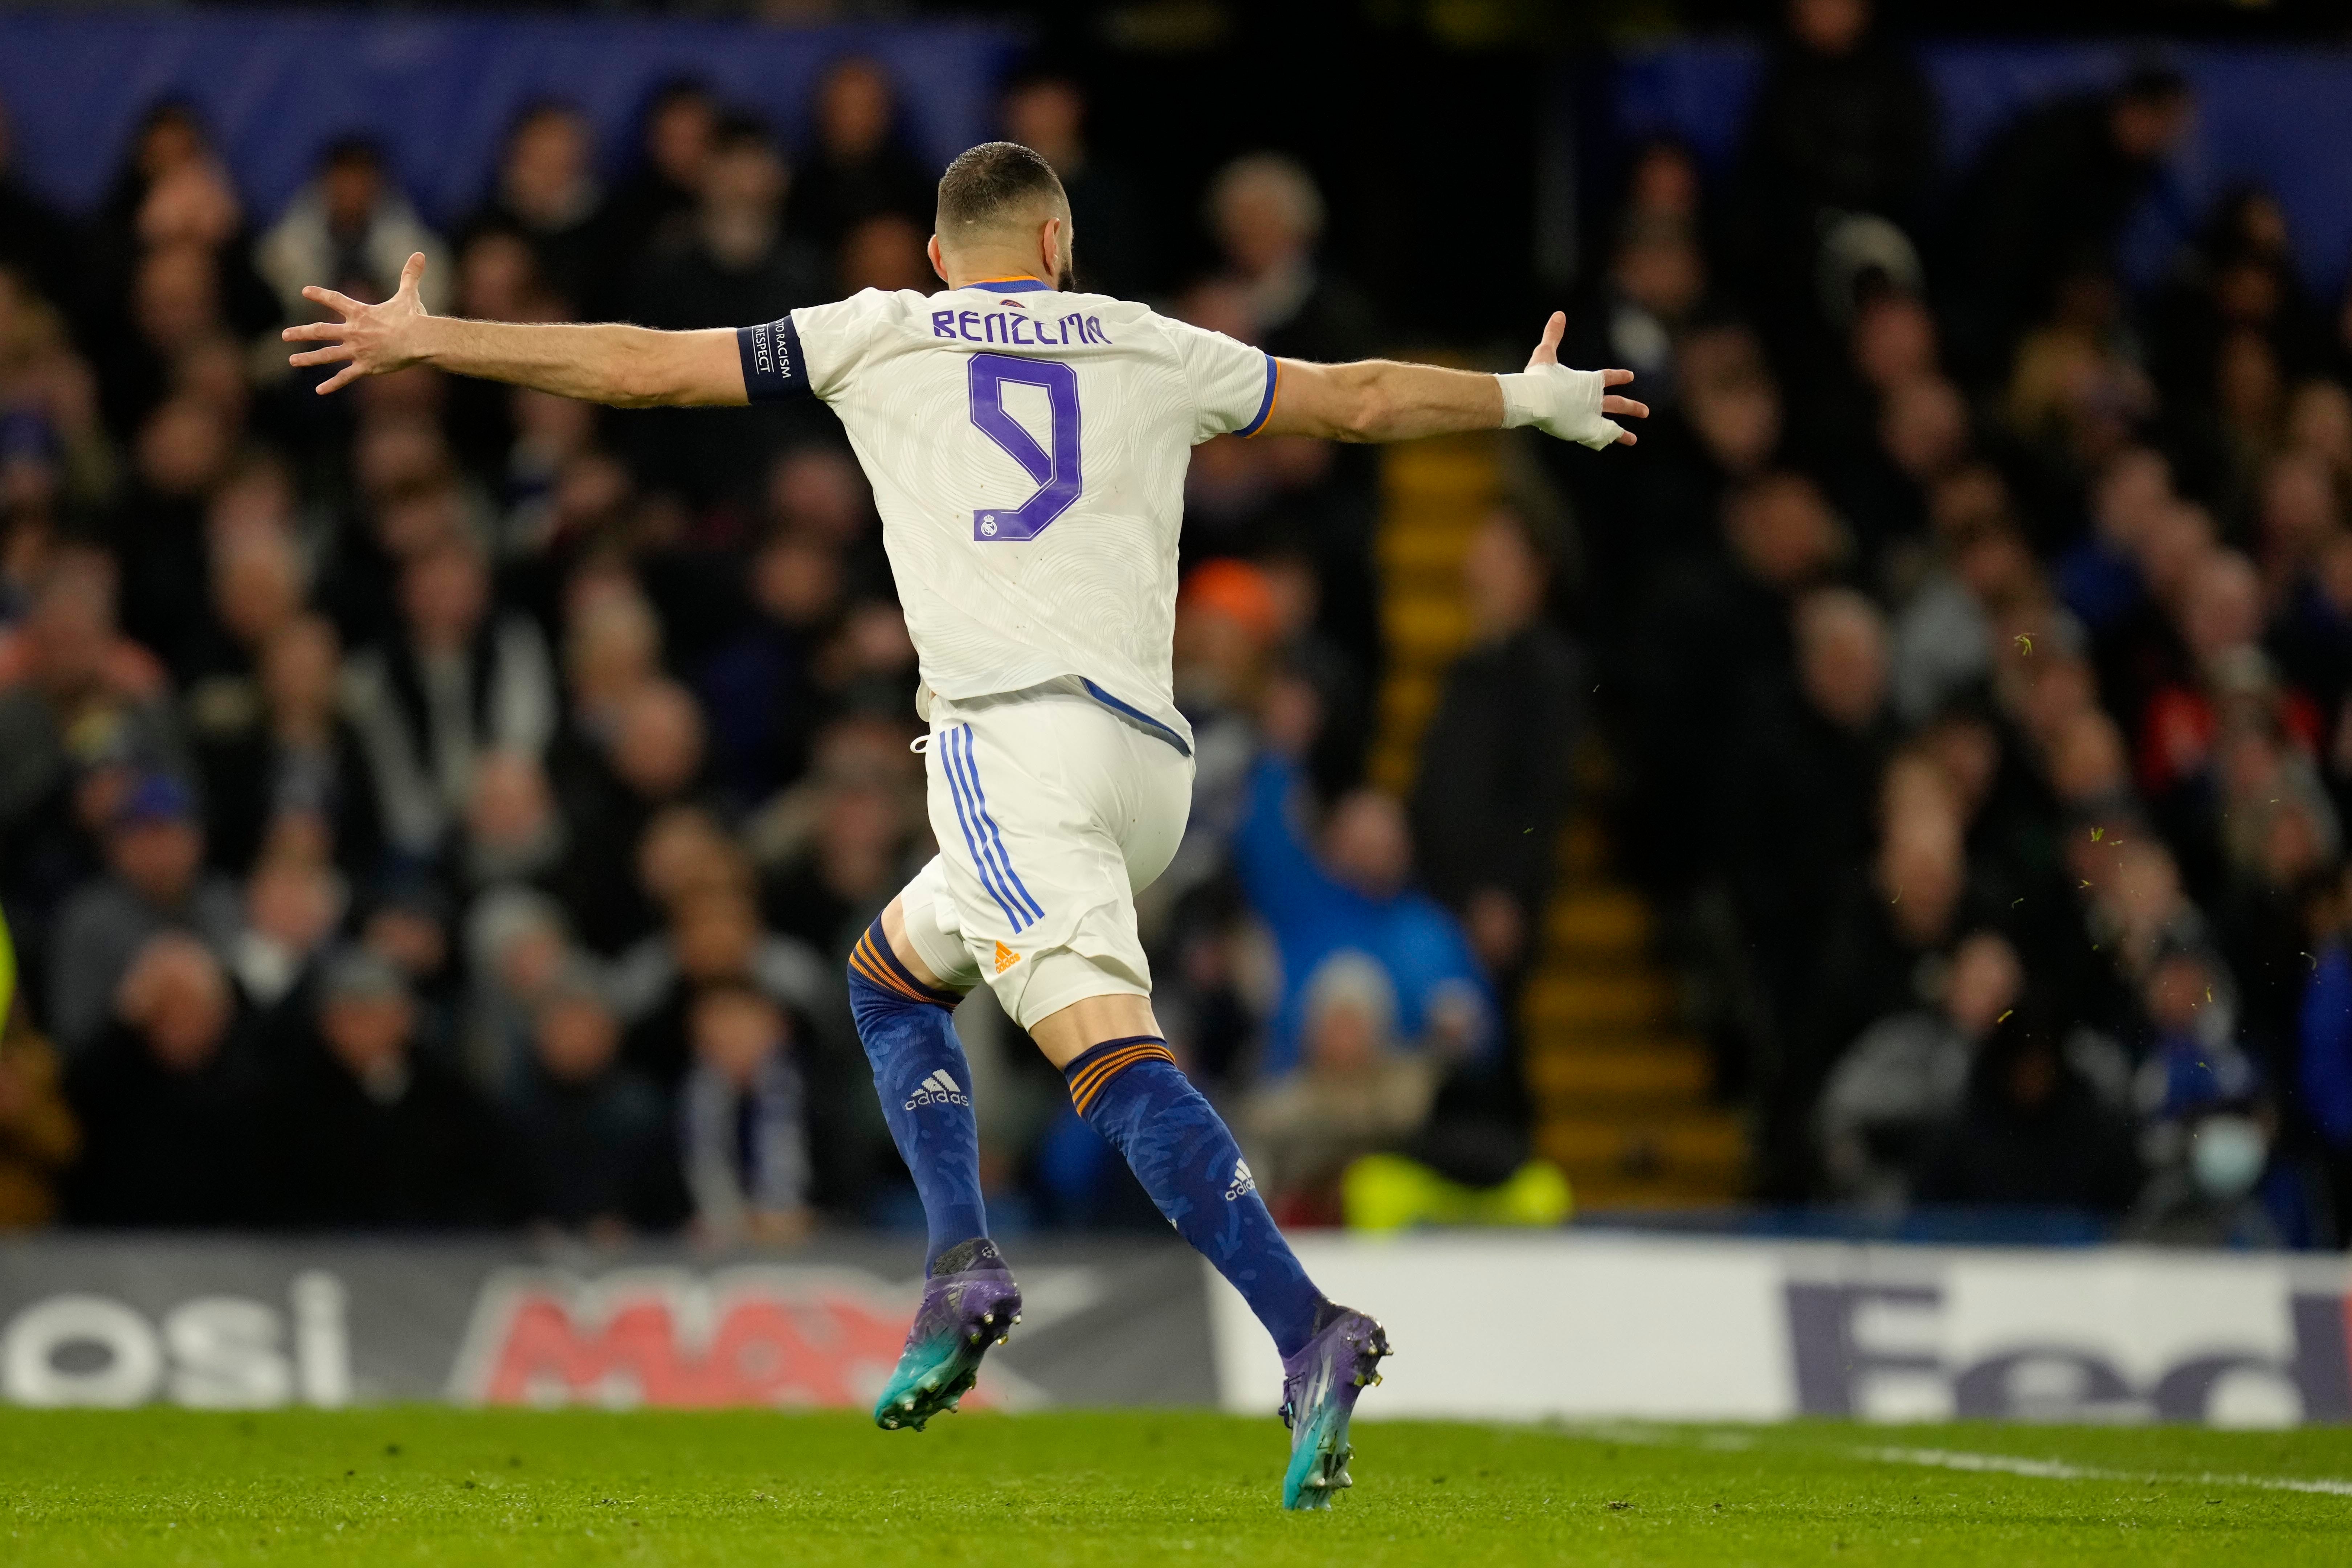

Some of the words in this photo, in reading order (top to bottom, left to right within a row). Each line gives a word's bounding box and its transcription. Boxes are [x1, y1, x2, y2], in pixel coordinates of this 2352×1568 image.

[775, 322, 784, 332] TO
[932, 310, 1112, 344] BENZEMA
[755, 328, 770, 372] RESPECT
[776, 334, 791, 378] RACISM
[967, 351, 1082, 541] 9
[996, 953, 1021, 974] adidas
[905, 1090, 969, 1111] adidas
[1225, 1179, 1255, 1201] adid
[1780, 1283, 2352, 1426] Fed
